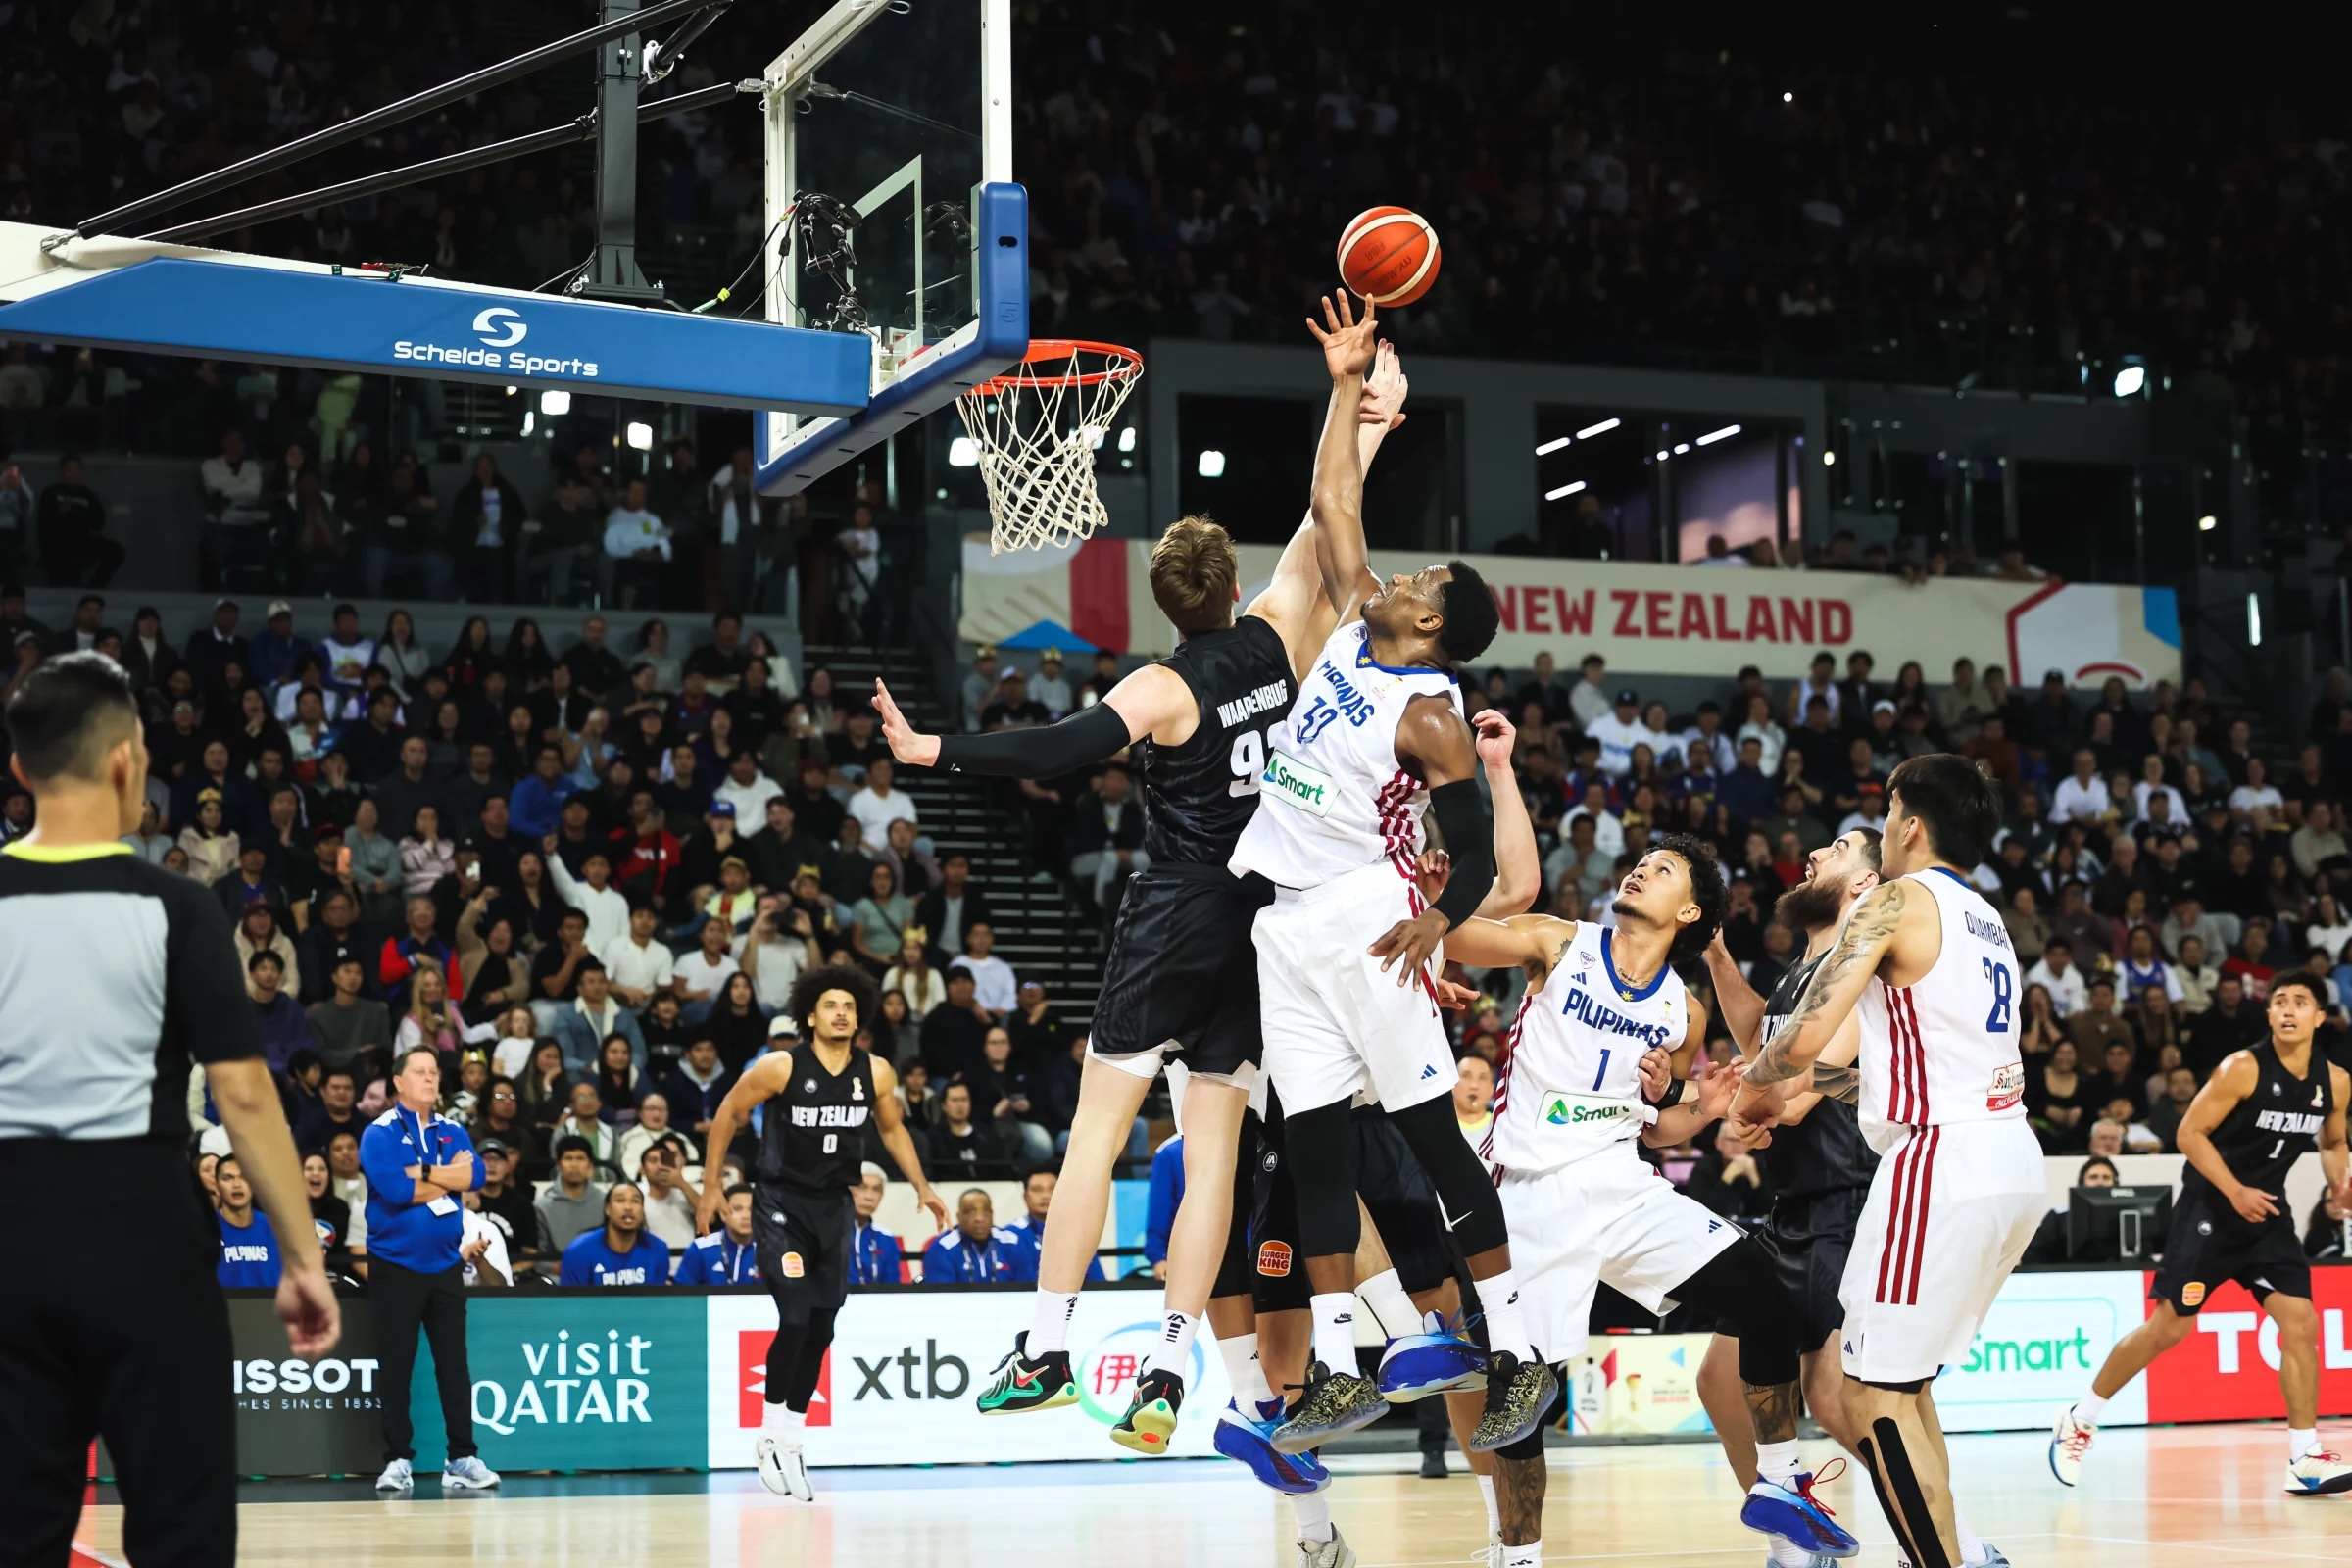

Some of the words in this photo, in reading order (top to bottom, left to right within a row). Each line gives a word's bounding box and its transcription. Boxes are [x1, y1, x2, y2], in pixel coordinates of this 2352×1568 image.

[394, 341, 502, 368] Schelde
[509, 352, 599, 377] Sports
[1488, 584, 1595, 636] NEW
[1610, 590, 1853, 647] ZEALAND
[1228, 720, 1288, 798] 9
[1277, 766, 1326, 806] Smart
[1562, 987, 1670, 1049] PILIPINAS
[1592, 1048, 1611, 1092] 1
[823, 1133, 838, 1154] 0
[2268, 1139, 2286, 1159] 1
[1259, 1258, 1289, 1269] KING
[1260, 1250, 1290, 1260] BURGER
[522, 1329, 652, 1376] visit
[852, 1339, 970, 1401] xtb
[233, 1358, 379, 1394] ISSOT
[281, 1398, 334, 1410] SINCE
[471, 1379, 653, 1436] QATAR
